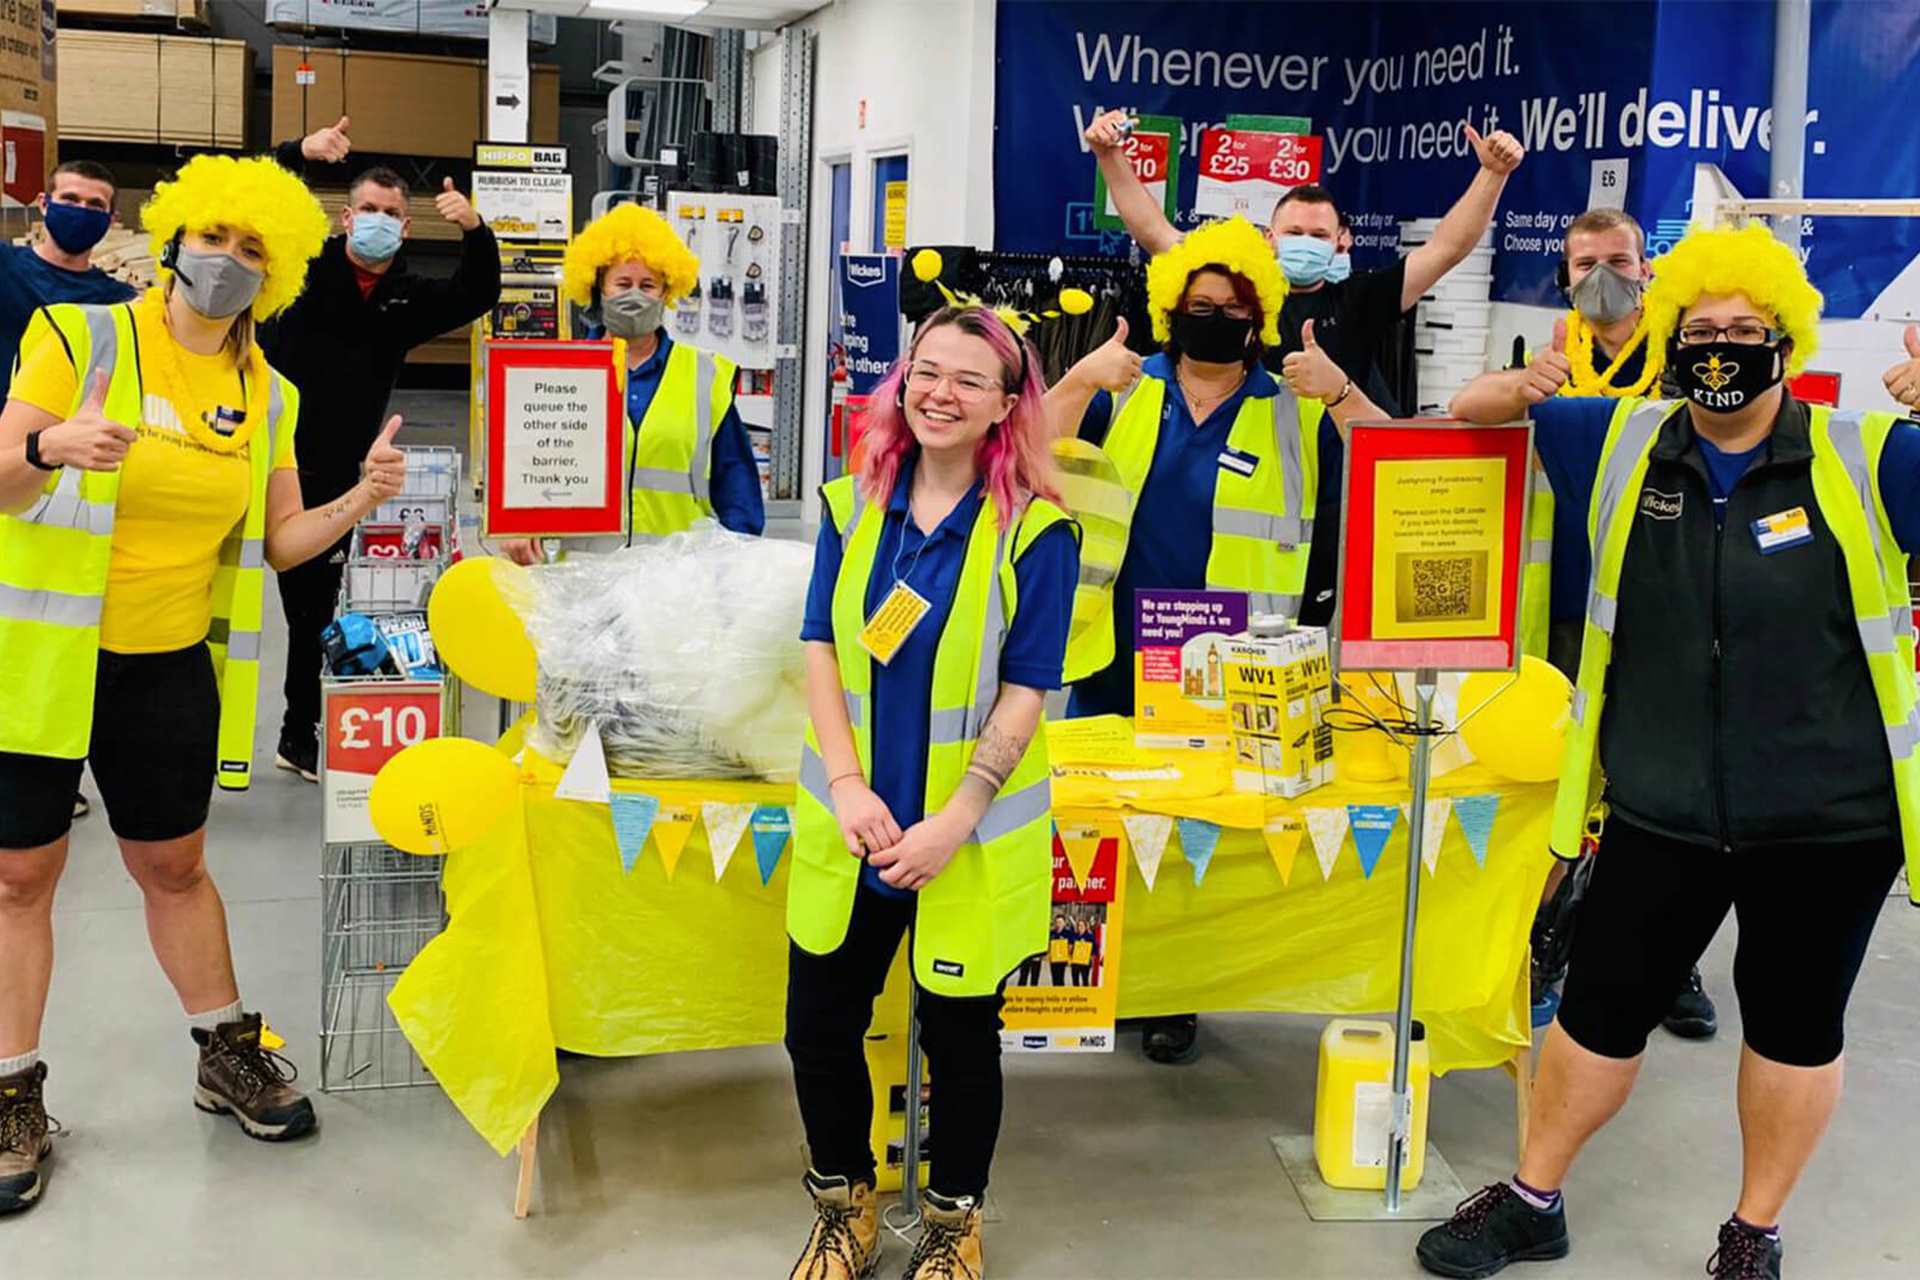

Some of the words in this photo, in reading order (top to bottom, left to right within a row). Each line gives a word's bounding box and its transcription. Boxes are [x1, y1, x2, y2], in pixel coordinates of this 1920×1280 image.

[1075, 32, 1328, 92] Whenever
[1344, 57, 1405, 105] you
[1412, 28, 1487, 88] need
[1495, 25, 1521, 76] it.
[1327, 127, 1391, 174] you
[1399, 106, 1473, 161] need
[1521, 91, 1607, 153] We'll
[1618, 87, 1826, 155] deliv.
[1124, 137, 1138, 156] 2
[1218, 135, 1231, 154] 2
[1232, 140, 1248, 151] for
[1277, 138, 1290, 158] 2
[1292, 145, 1307, 155] for
[483, 151, 527, 161] HIPPO
[534, 152, 562, 163] BAG
[1209, 155, 1249, 176] £25
[1269, 159, 1310, 180] £30
[478, 176, 517, 187] RUBBISH
[520, 177, 531, 187] TO
[533, 178, 567, 188] CLEAR?
[1601, 171, 1616, 187] £6
[1346, 212, 1369, 227] ext
[1505, 210, 1533, 228] Same
[1534, 210, 1559, 232] day
[1504, 233, 1542, 251] Choose
[856, 357, 891, 375] other
[534, 382, 578, 394] Please
[1693, 388, 1744, 407] KIND
[523, 402, 564, 413] queue
[567, 401, 588, 412] the
[523, 420, 557, 430] other
[561, 420, 588, 431] side
[536, 438, 550, 448] of
[553, 438, 574, 448] the
[532, 456, 578, 467] barrier,
[522, 473, 562, 484] Thank
[565, 475, 589, 486] you
[1141, 599, 1155, 610] We
[1157, 602, 1171, 611] are
[1173, 600, 1210, 614] stepping
[1211, 603, 1223, 614] up
[1141, 612, 1154, 623] for
[1156, 612, 1207, 627] YoungMinds
[1209, 615, 1216, 625] &
[1218, 616, 1231, 626] we
[1141, 627, 1163, 638] need
[1164, 627, 1184, 640] you!
[1239, 666, 1276, 685] WV1
[1301, 656, 1327, 677] WV1
[339, 705, 427, 750] £10
